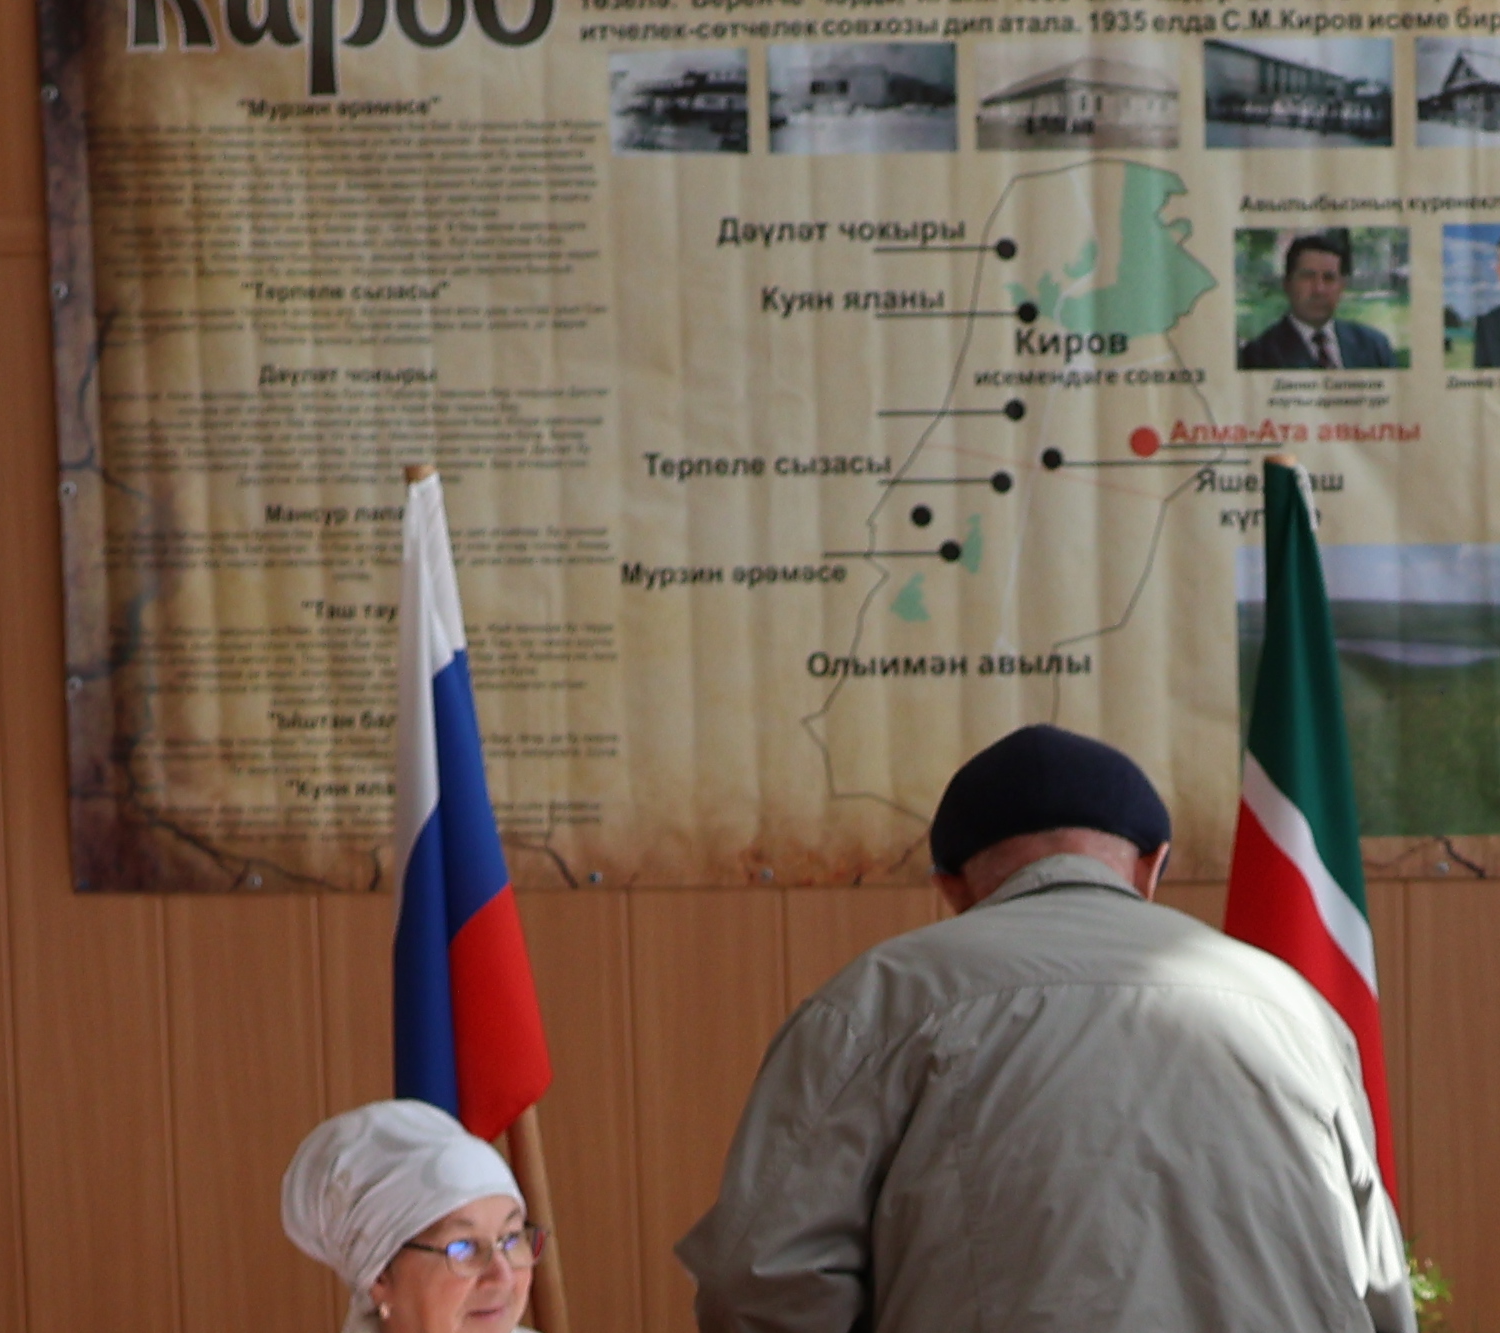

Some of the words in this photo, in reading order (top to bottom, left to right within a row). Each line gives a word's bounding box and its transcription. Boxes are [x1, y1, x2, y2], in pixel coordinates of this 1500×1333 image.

[1090, 9, 1148, 33] 1935
[839, 221, 966, 246] чокыры
[761, 286, 833, 319] Куян
[842, 289, 945, 312] яланы
[1015, 329, 1129, 364] Киров
[1124, 366, 1206, 386] совхоз
[1169, 419, 1308, 443] Алма-Ата
[1318, 421, 1421, 443] авылы
[643, 452, 766, 483] Терпеле
[773, 455, 892, 475] сызасы
[621, 562, 723, 591] Мурзин
[806, 650, 968, 678] Олыимән
[978, 651, 1092, 676] авылы
